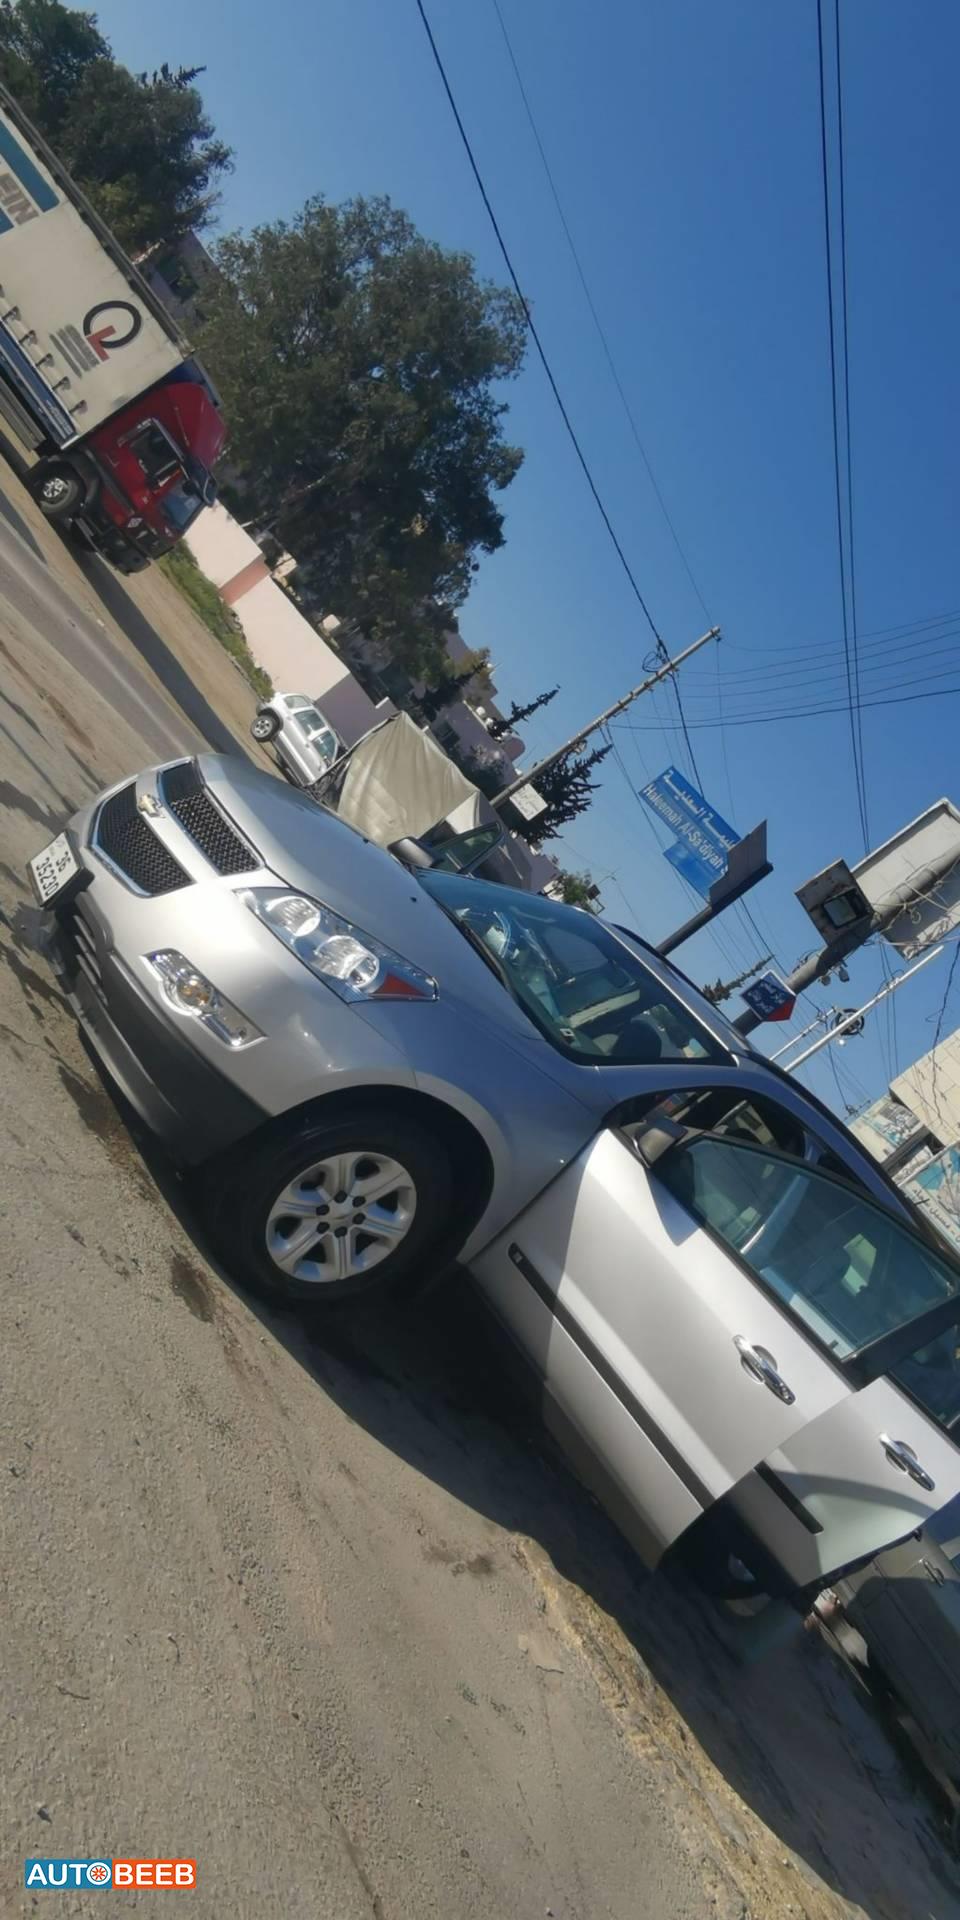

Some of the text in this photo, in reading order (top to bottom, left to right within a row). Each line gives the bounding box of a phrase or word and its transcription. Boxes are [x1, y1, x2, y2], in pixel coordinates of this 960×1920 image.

[643, 783, 682, 826] Haleemah
[678, 821, 724, 869] Al-Sa'diyah
[36, 857, 60, 896] 35230
[55, 851, 71, 873] 36
